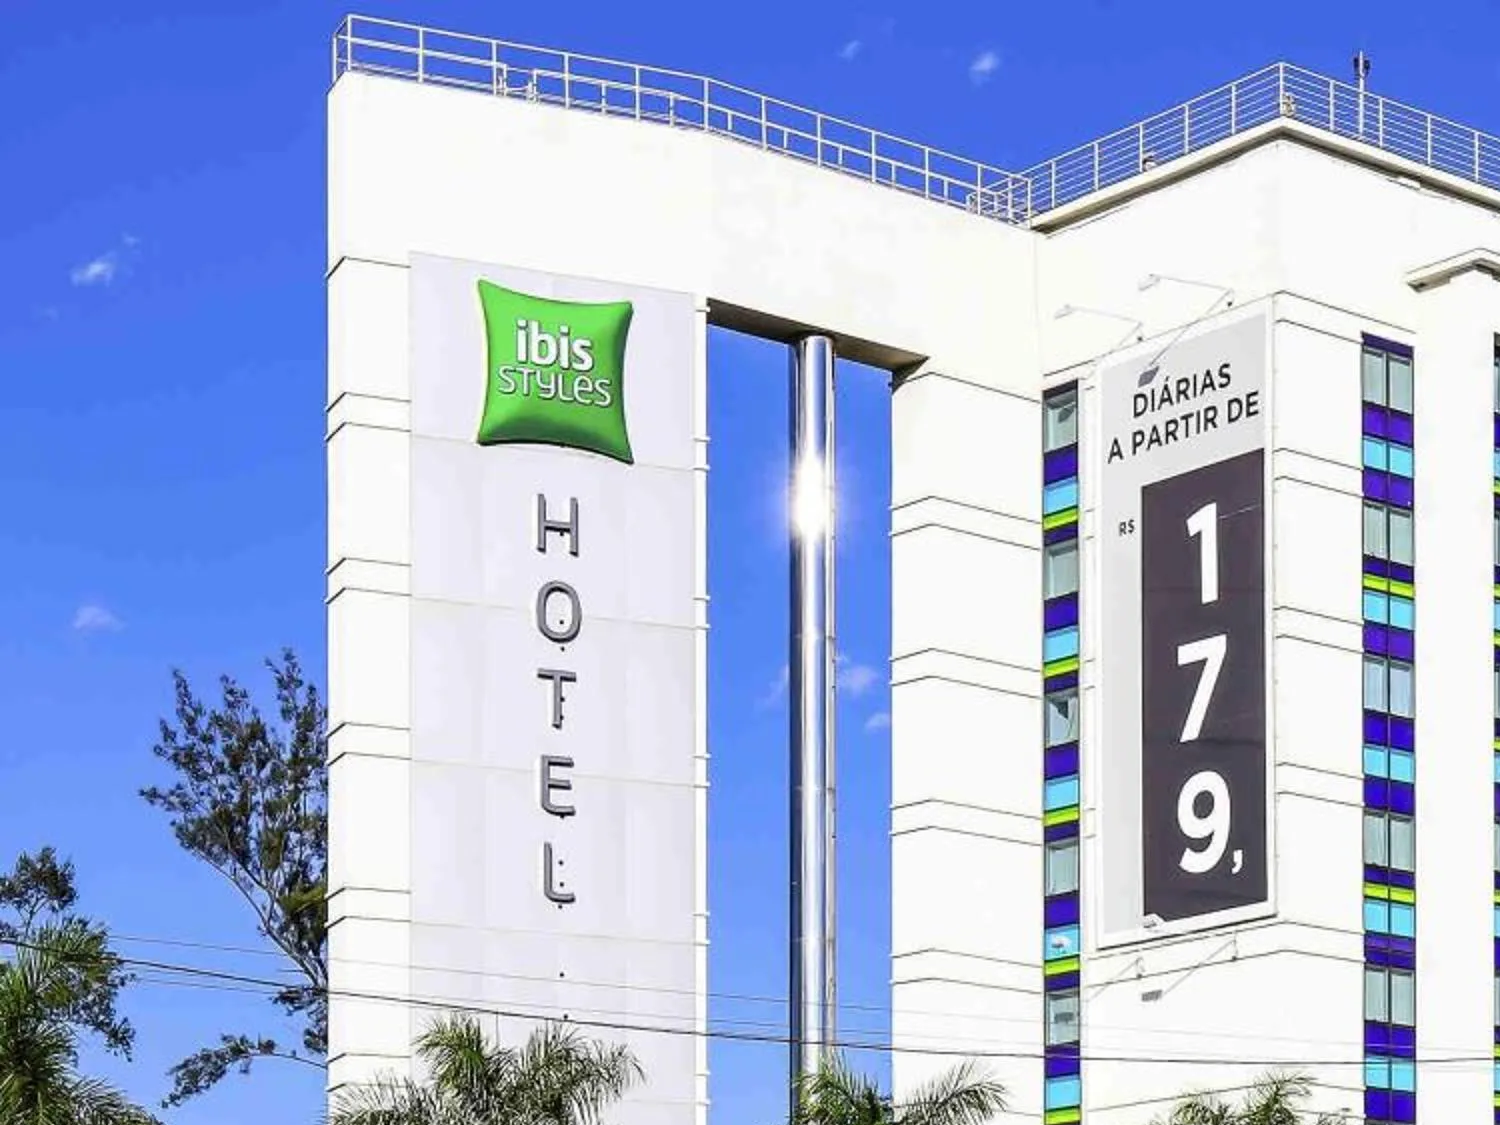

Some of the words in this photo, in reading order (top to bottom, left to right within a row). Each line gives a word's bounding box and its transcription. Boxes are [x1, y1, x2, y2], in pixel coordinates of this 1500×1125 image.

[516, 319, 594, 372] ibis
[1132, 362, 1232, 419] DIÁRIAS
[1107, 436, 1125, 465] A
[1131, 404, 1219, 456] PARTIR
[1226, 390, 1260, 425] DE
[1118, 518, 1136, 537] R$
[536, 493, 582, 905] HOTEL
